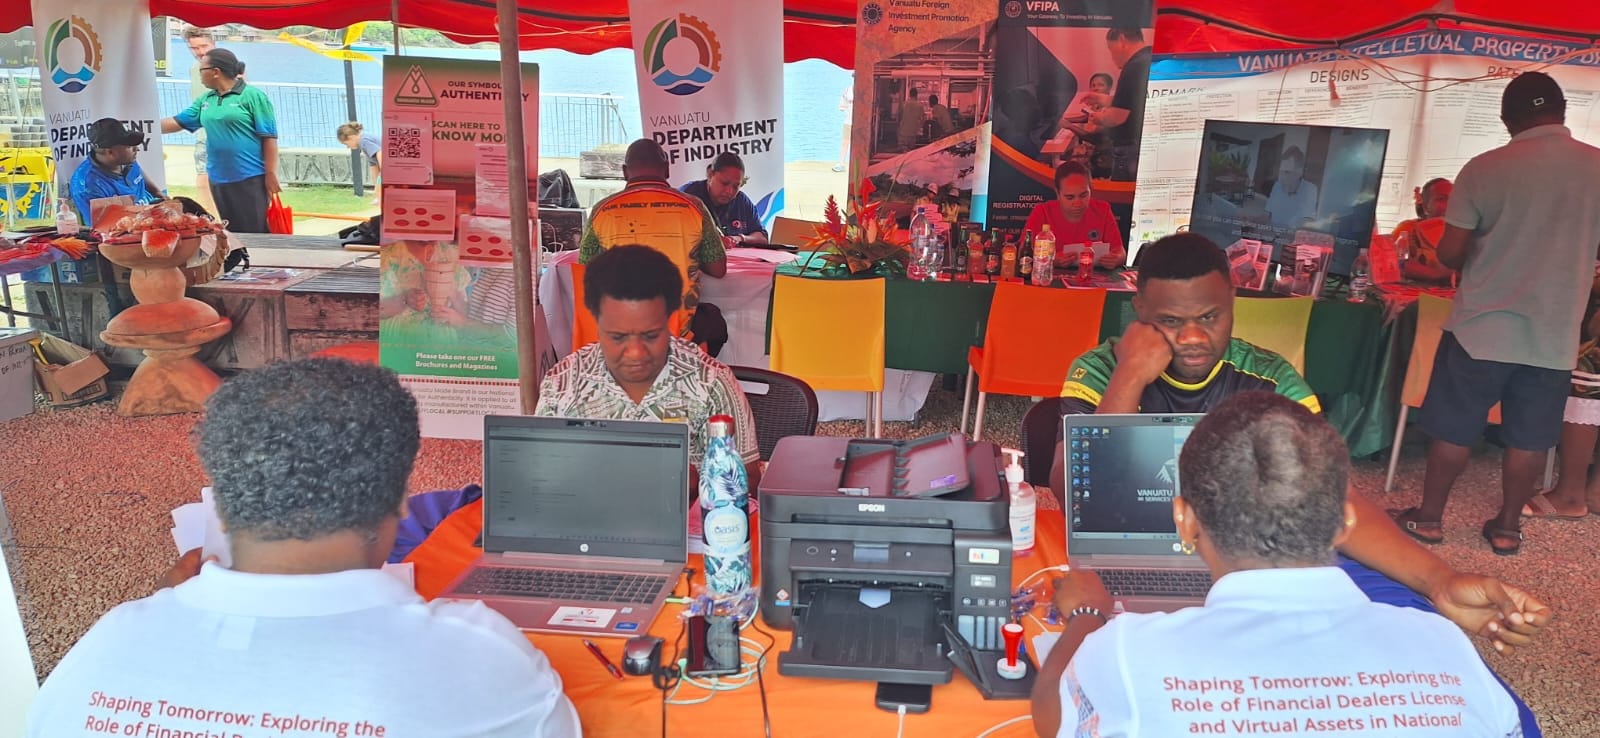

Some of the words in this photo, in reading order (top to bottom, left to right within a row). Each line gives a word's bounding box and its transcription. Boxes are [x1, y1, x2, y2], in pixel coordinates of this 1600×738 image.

[922, 0, 950, 9] Foreign
[1026, 1, 1060, 12] VFIPA
[888, 12, 930, 20] Investment
[931, 13, 969, 22] Promotion
[888, 24, 916, 33] Agency
[1238, 51, 1326, 71] VANUAT
[1328, 32, 1464, 60] TELLETUAL
[1472, 36, 1577, 61] PROPERTY
[1310, 68, 1369, 83] DESIGNS
[448, 80, 466, 88] OUR
[468, 81, 502, 89] SYMBOL
[440, 89, 530, 101] AUTHENTIY
[49, 109, 90, 125] VANUATU
[650, 111, 710, 128] VANUATU
[432, 120, 457, 129] SCAN
[460, 122, 485, 130] HERE
[488, 123, 501, 131] TO
[652, 118, 778, 146] DEPARTMENT
[432, 130, 475, 142] KNOW
[54, 145, 68, 162] OF
[684, 137, 773, 163] INDUSTRY
[416, 360, 448, 368] Brochures
[463, 363, 498, 371] Magazines
[1136, 489, 1173, 497] VANUATU
[858, 503, 885, 512] EPSON
[1163, 675, 1244, 694] Shaping
[1250, 675, 1352, 691] Tomorrow:
[1357, 669, 1437, 689] Exploring
[1439, 671, 1461, 686] the
[1171, 697, 1214, 713] Role
[1220, 697, 1240, 712] of
[1247, 694, 1332, 711] Financial
[1338, 692, 1406, 709] Dealers
[1411, 690, 1466, 707] License
[89, 691, 153, 719] Shaping
[158, 700, 255, 727] Tomorrow:
[260, 712, 349, 738] Exploring
[354, 720, 386, 738] the
[85, 715, 119, 734] Role
[124, 721, 143, 737] of
[1189, 719, 1226, 734] and
[1232, 717, 1297, 734] Virtual
[1304, 717, 1365, 732] Assets
[1369, 714, 1388, 730] in
[1393, 712, 1462, 729] National
